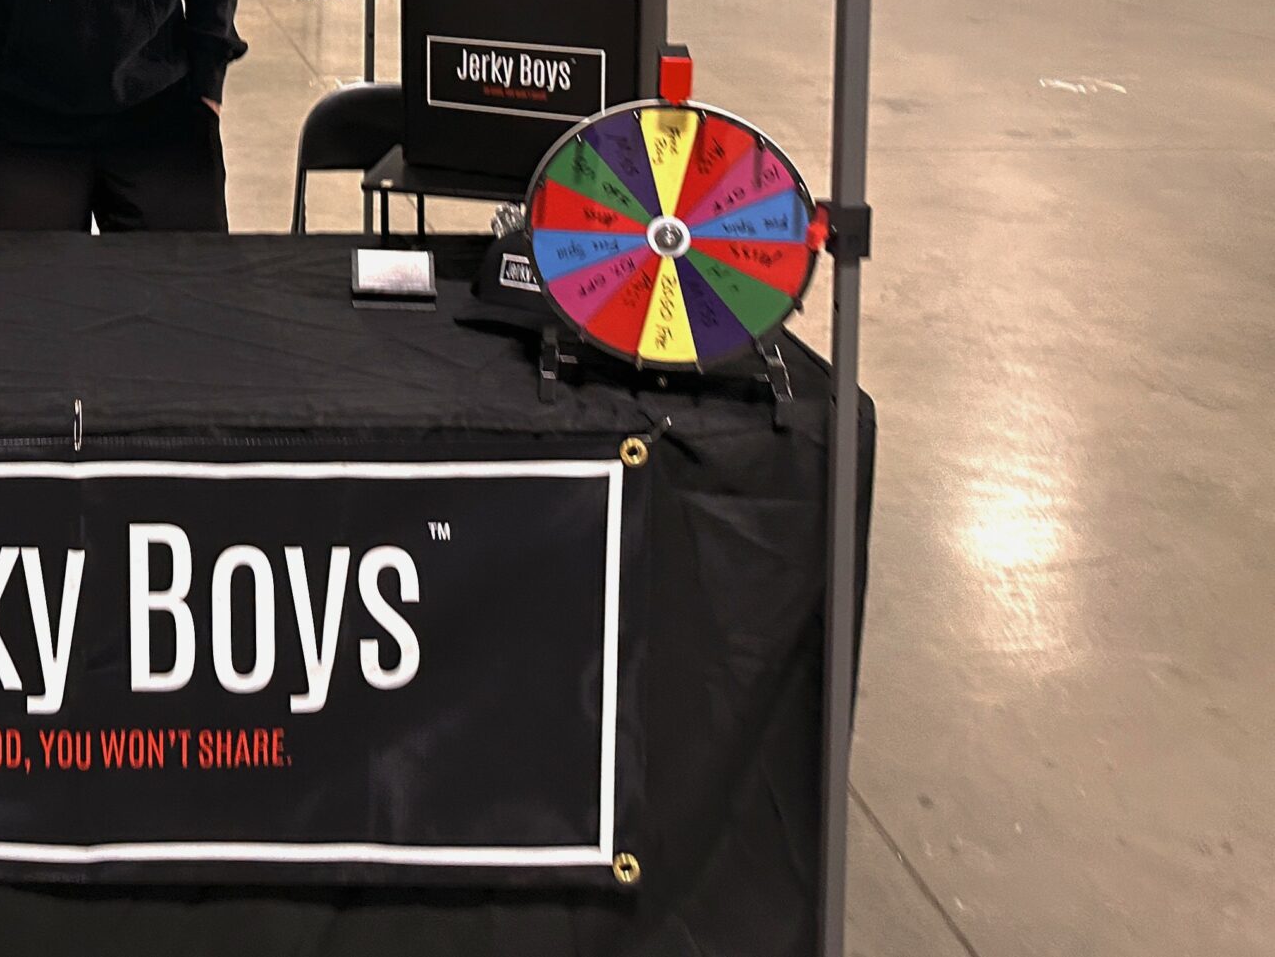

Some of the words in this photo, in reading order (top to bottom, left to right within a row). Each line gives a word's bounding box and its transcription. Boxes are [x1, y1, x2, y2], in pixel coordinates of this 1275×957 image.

[456, 48, 514, 88] Jerky
[519, 53, 571, 92] Boys
[128, 522, 421, 714] Boys
[39, 729, 92, 771] YOU
[100, 728, 191, 770] WON'T
